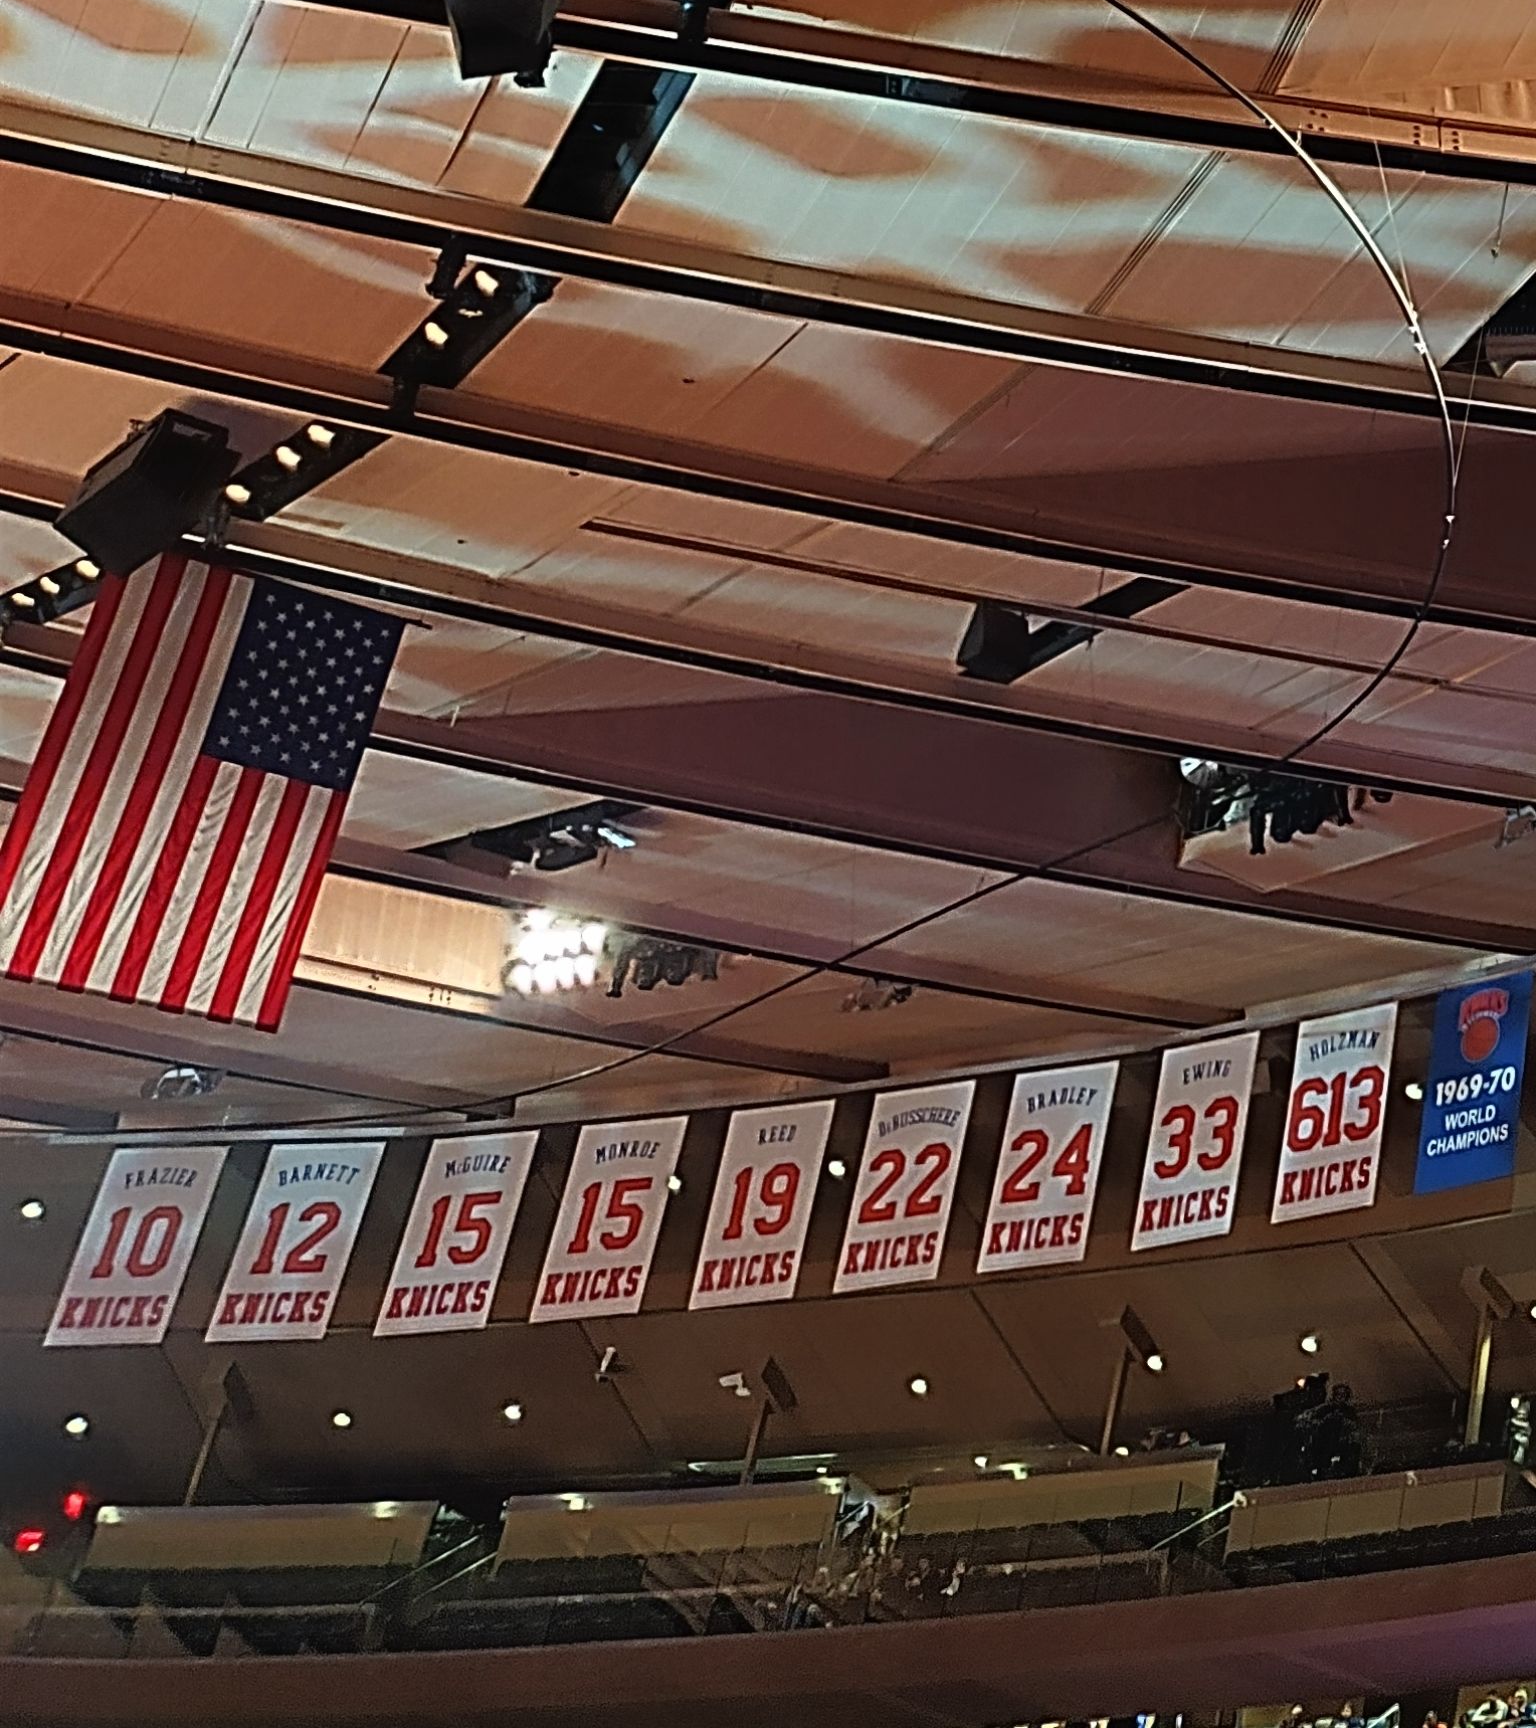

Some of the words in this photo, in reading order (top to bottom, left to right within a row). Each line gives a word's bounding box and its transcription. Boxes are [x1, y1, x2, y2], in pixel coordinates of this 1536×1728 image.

[1309, 1030, 1380, 1062] HOLZMAN
[1182, 1059, 1232, 1085] EWING
[1436, 1066, 1516, 1106] 1969-70
[1027, 1087, 1098, 1113] BRADLEY
[1286, 1065, 1385, 1152] 613
[1444, 1104, 1496, 1131] WORLD
[759, 1125, 797, 1145] REED
[878, 1107, 961, 1137] DeBUSSCHERE
[1154, 1096, 1239, 1180] 33
[1426, 1124, 1509, 1157] CHAMPIONS
[445, 1155, 511, 1178] McGUIRE
[596, 1141, 660, 1164] MONROE
[1000, 1123, 1093, 1204] 24
[125, 1167, 197, 1189] FRAZIER
[278, 1163, 361, 1186] BARNETT
[858, 1142, 952, 1223] 22
[1279, 1157, 1372, 1205] KNICKS
[567, 1177, 653, 1254] 15
[722, 1162, 800, 1240] 19
[1139, 1185, 1230, 1232] KNICKS
[90, 1206, 183, 1278] 10
[249, 1201, 342, 1274] 12
[415, 1191, 503, 1268] 15
[987, 1212, 1084, 1255] KNICKS
[698, 1250, 796, 1292] KNICKS
[843, 1231, 939, 1275] KNICKS
[386, 1280, 491, 1319] KNICKS
[540, 1266, 643, 1305] KNICKS
[58, 1295, 169, 1329] KNICKS
[218, 1290, 330, 1324] KNICKS
